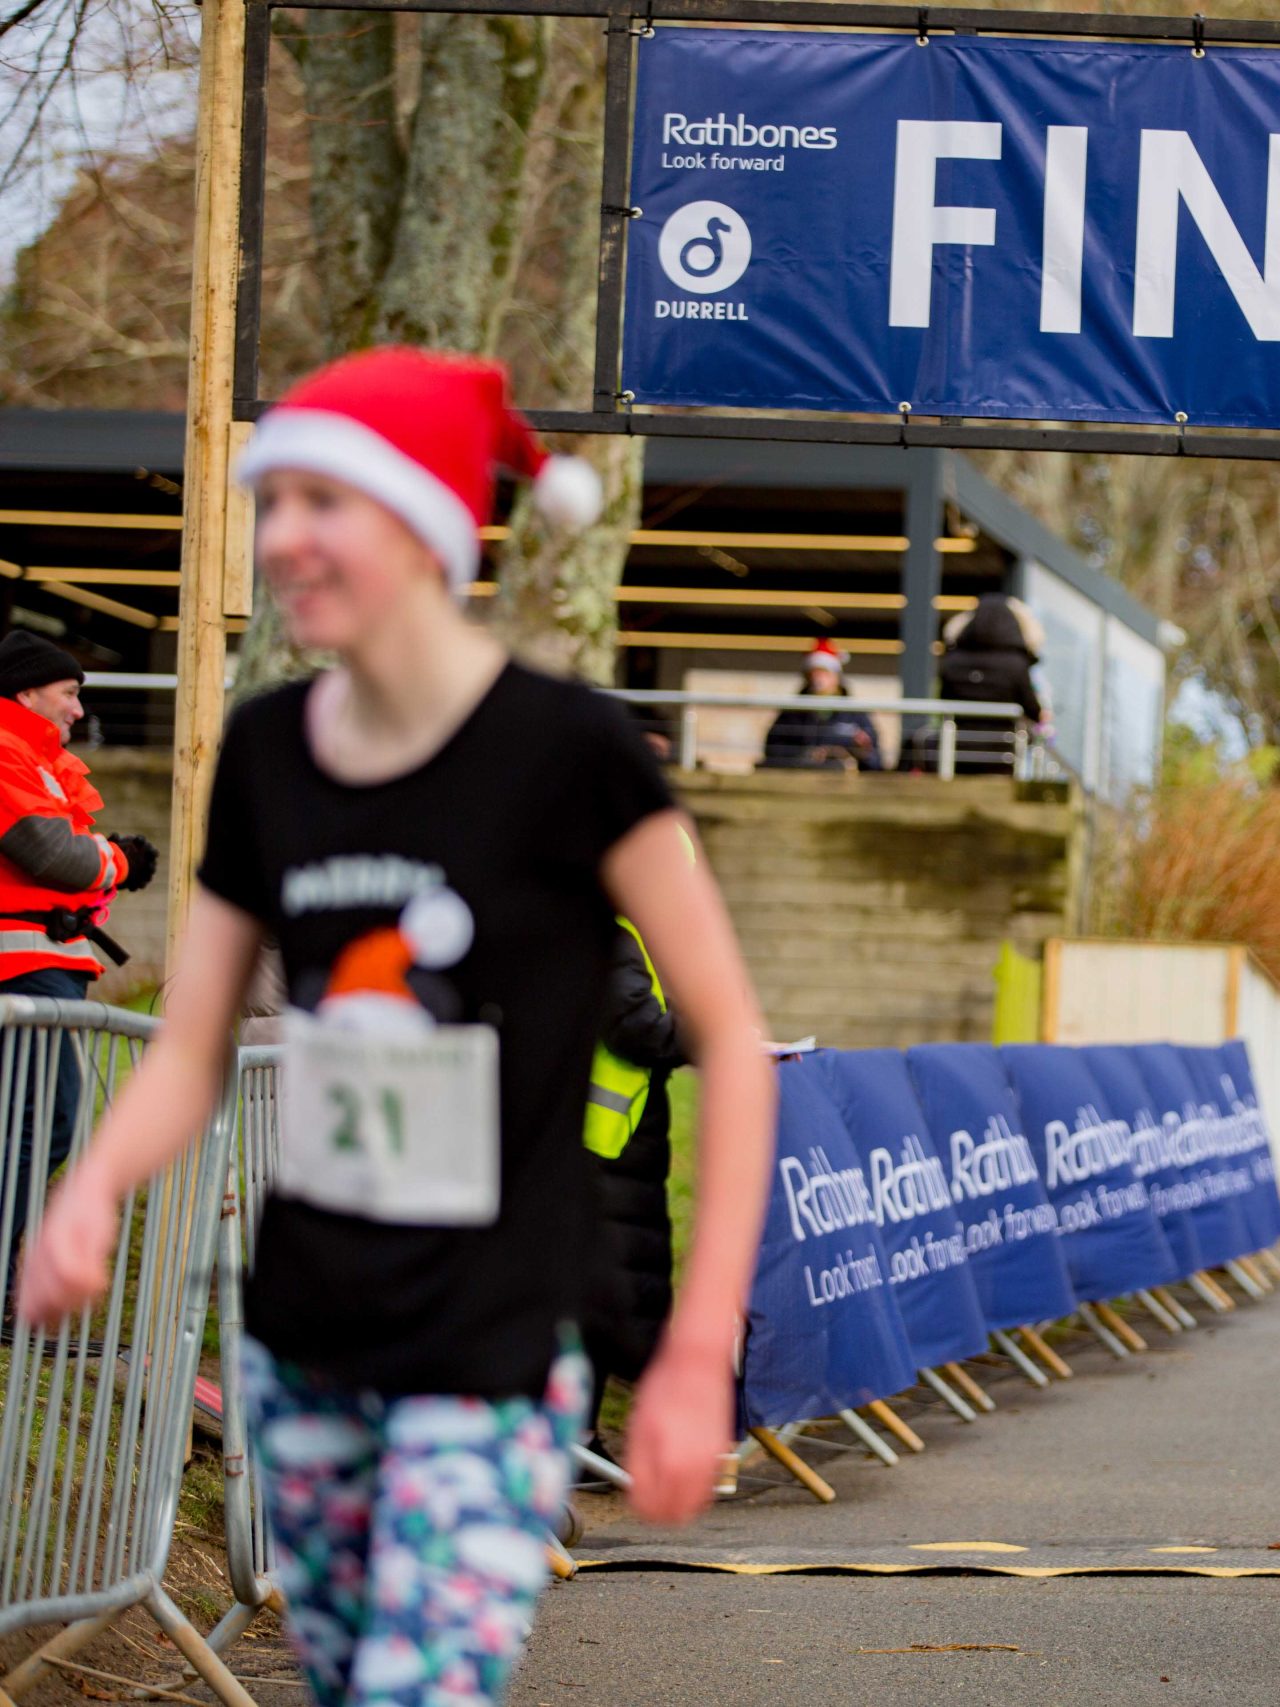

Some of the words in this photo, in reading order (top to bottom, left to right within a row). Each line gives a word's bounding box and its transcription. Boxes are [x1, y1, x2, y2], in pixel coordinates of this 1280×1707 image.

[662, 112, 838, 150] Rathbones
[661, 152, 706, 169] Look
[710, 152, 785, 172] forward
[654, 300, 749, 321] DURRELL
